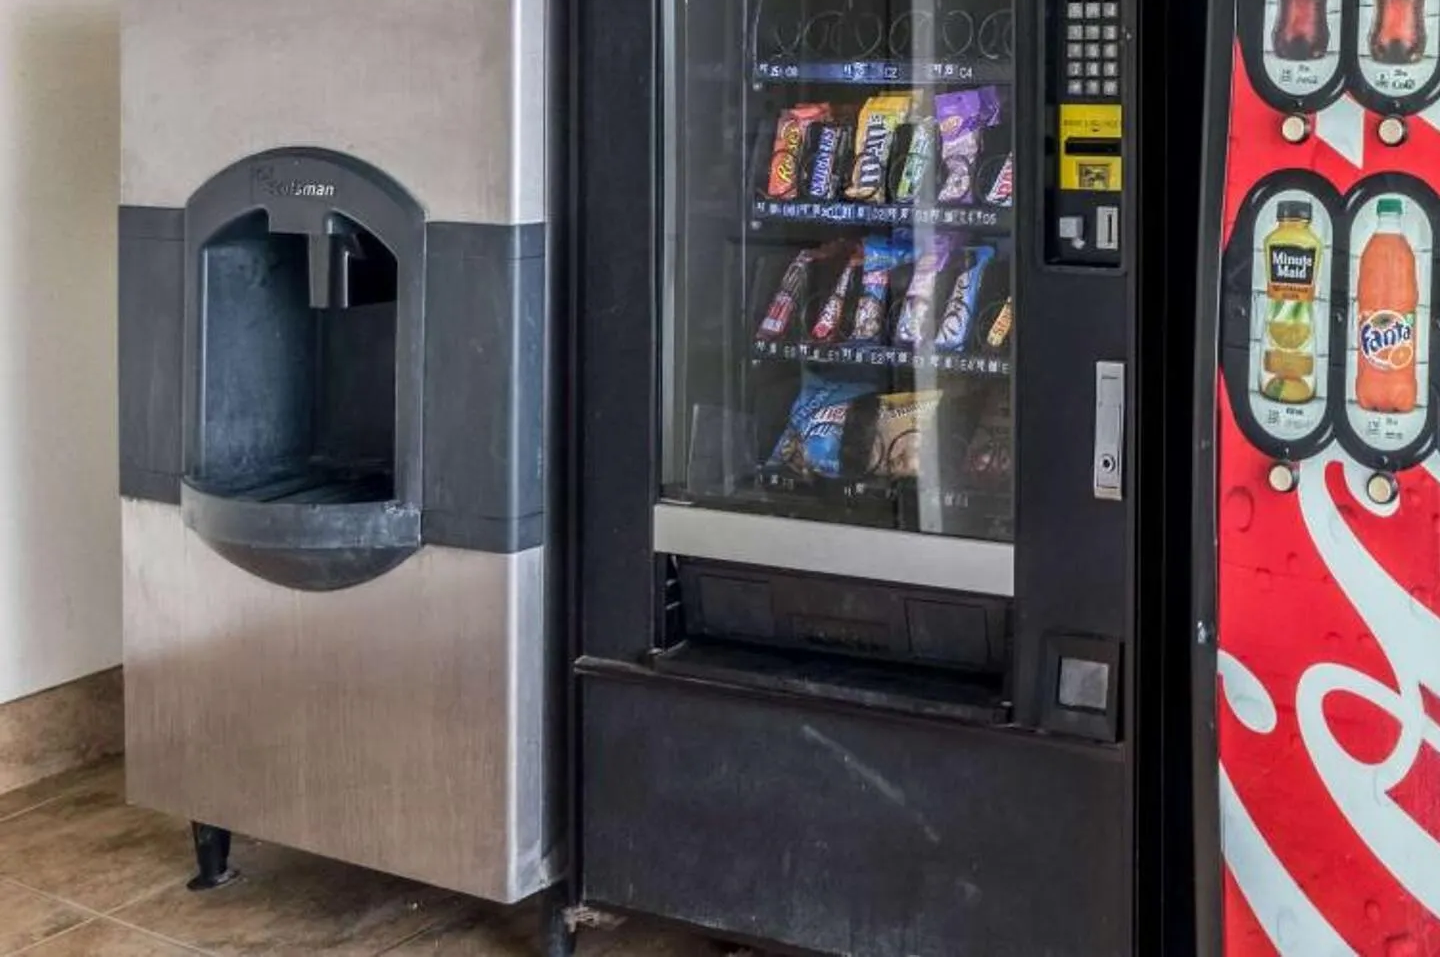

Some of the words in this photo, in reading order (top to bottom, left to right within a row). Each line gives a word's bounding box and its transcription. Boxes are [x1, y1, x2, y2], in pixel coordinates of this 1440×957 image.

[959, 67, 972, 78] C4
[809, 126, 837, 197] SNICKERS
[1272, 251, 1313, 267] Minute
[1276, 264, 1307, 279] Maid
